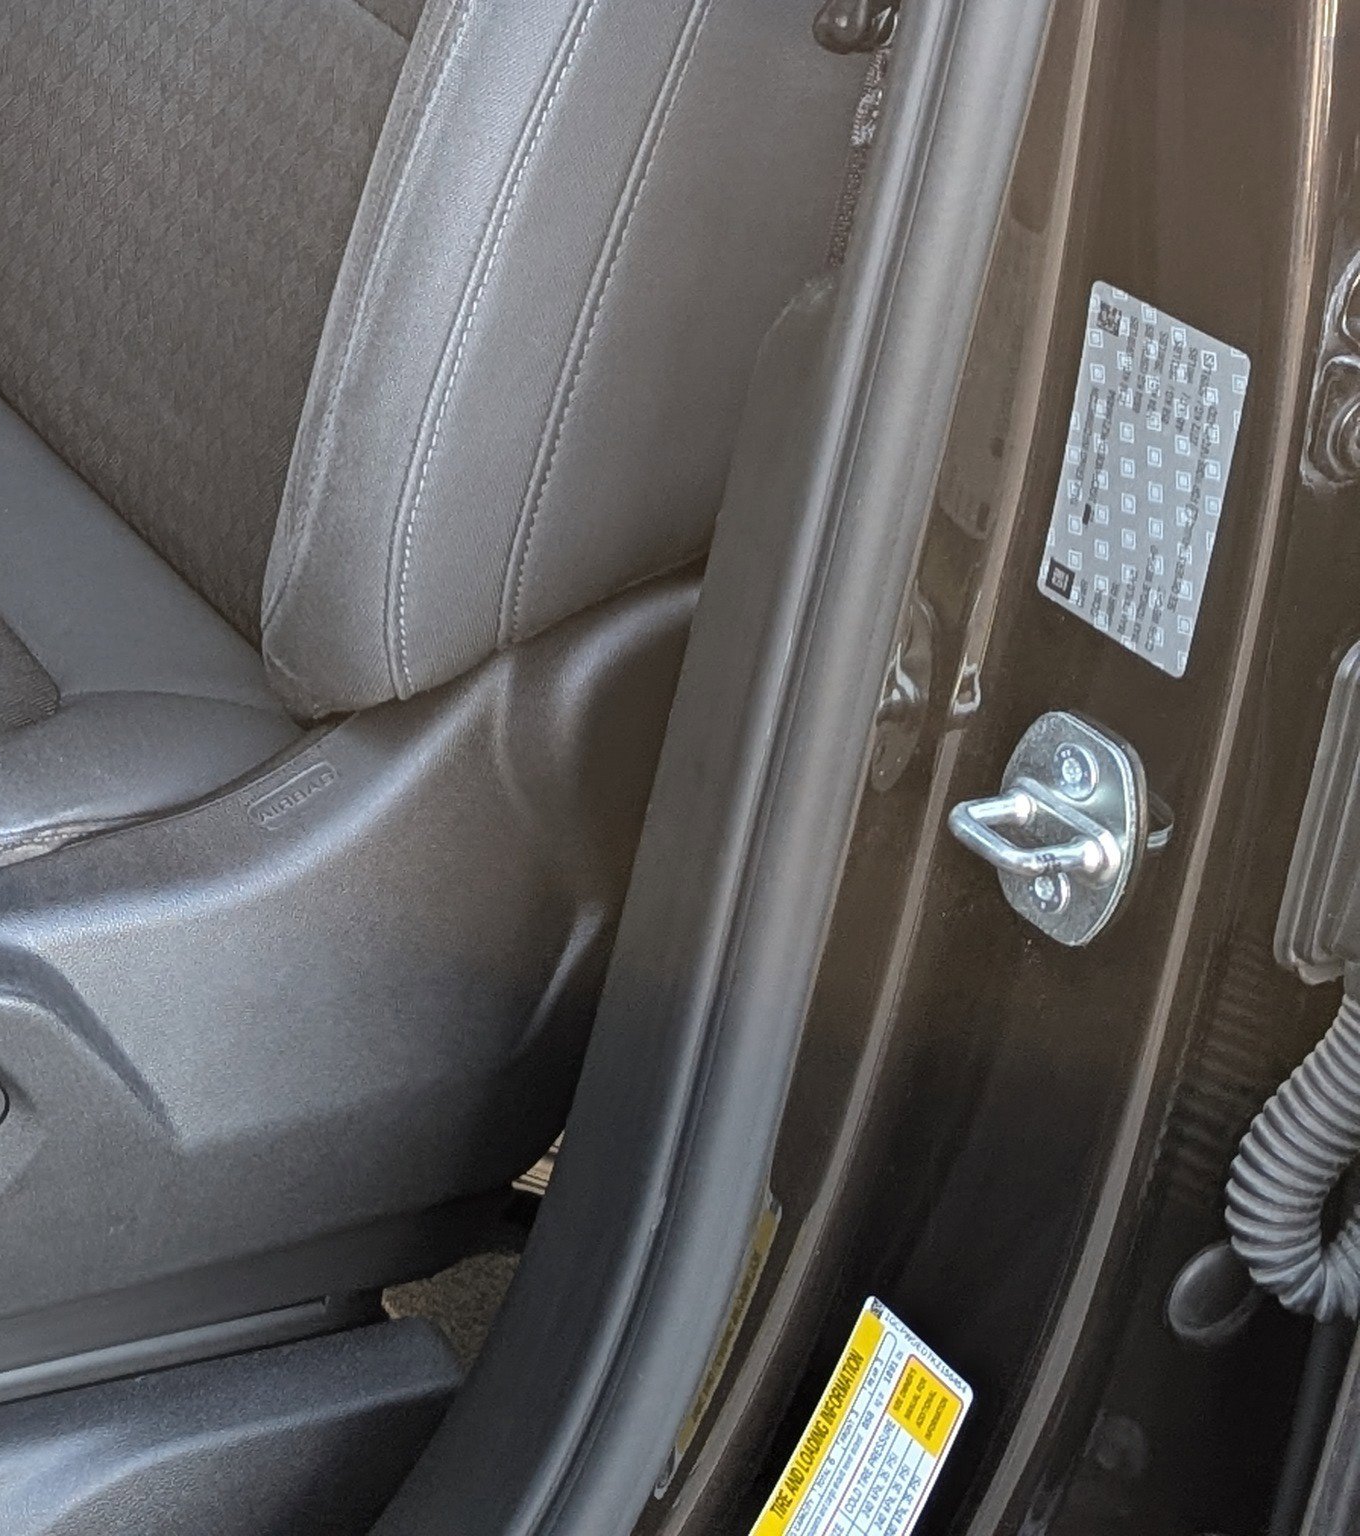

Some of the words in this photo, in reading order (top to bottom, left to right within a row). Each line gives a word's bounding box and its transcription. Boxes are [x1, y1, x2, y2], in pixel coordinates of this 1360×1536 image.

[257, 770, 337, 823] AIRBAG
[770, 1488, 793, 1520] TIRE
[783, 1465, 805, 1498] AND
[796, 1420, 830, 1474] LOADING
[820, 1348, 864, 1429] INFORMATION
[843, 1485, 863, 1514] COLD
[856, 1465, 874, 1490] TIRE
[868, 1419, 896, 1469] PRESSURE
